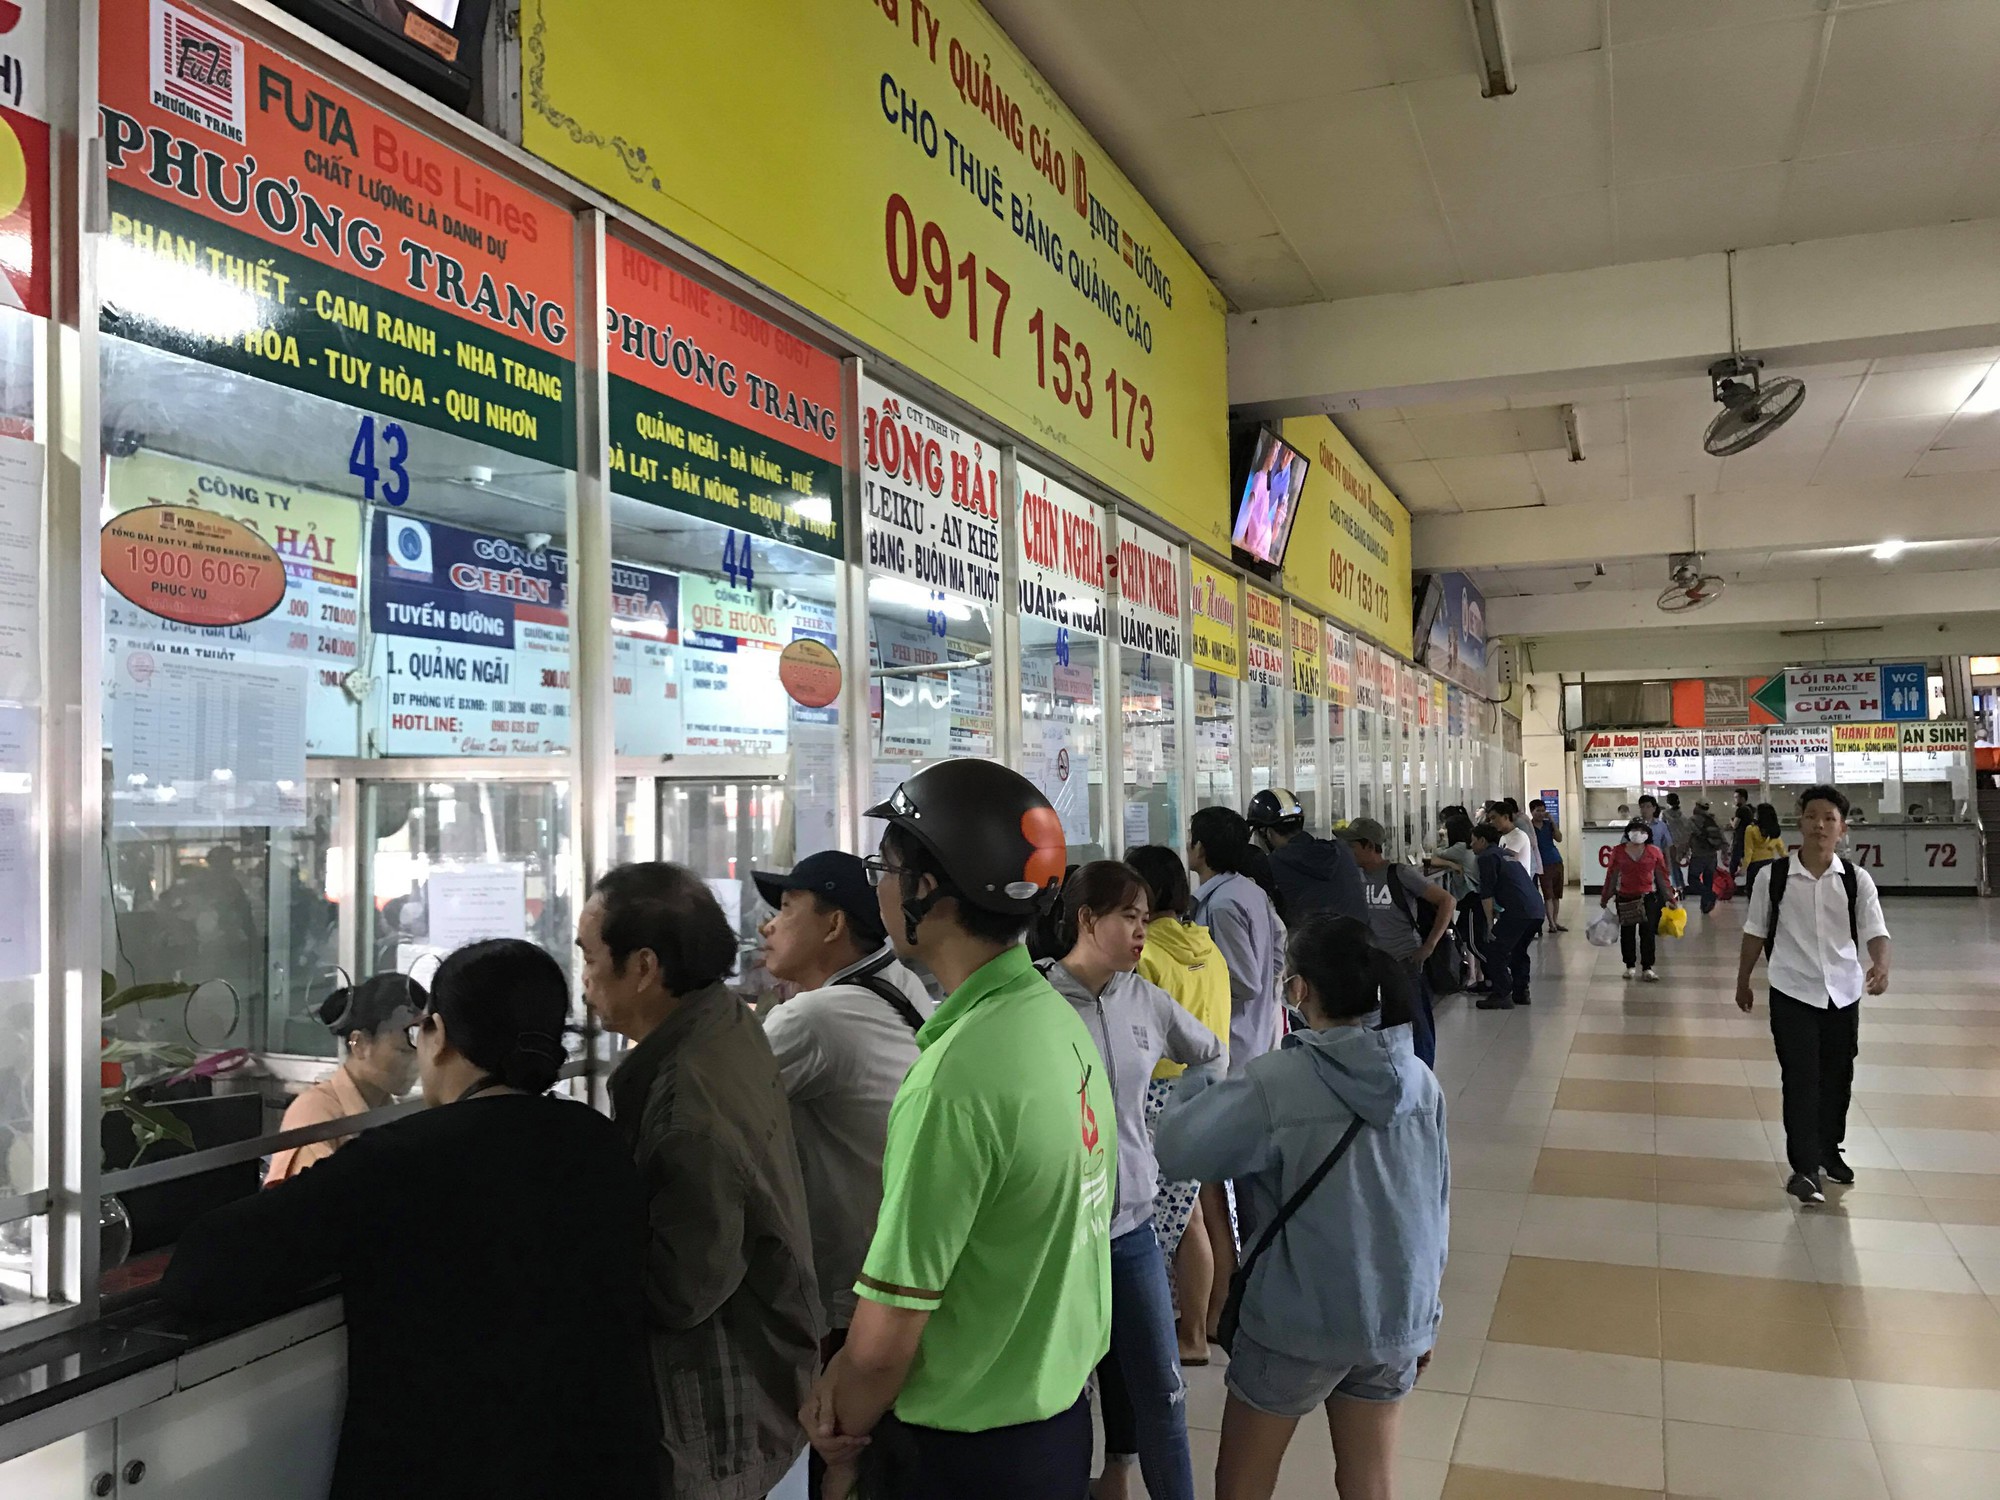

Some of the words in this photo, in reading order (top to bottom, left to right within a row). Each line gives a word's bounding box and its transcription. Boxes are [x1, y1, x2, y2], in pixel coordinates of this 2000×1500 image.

[911, 0, 940, 65] TY
[949, 37, 1024, 155] QUẢNG
[1029, 124, 1066, 195] CÁO
[204, 114, 243, 143] TRANG
[259, 64, 360, 158] FUTA
[373, 124, 444, 198] Bus
[454, 166, 538, 244] Lines
[99, 102, 386, 271] PHƯƠNG
[400, 238, 568, 345] TRANG
[304, 149, 353, 189] CHẤT
[358, 174, 415, 219] LƯỢNG
[418, 202, 438, 230] LÀ
[443, 214, 483, 250] DANH
[487, 235, 508, 264] DỰ
[880, 73, 938, 159] CHO
[944, 129, 1004, 221] THUÊ
[1011, 193, 1063, 275] BẢNG
[1068, 249, 1122, 328] QUẢNG
[1125, 304, 1152, 355] CÁO
[621, 246, 662, 293] HOT
[669, 271, 711, 318] LINE
[730, 304, 770, 348] 1900
[206, 246, 290, 305] THIẾT
[316, 289, 369, 334] CAM
[376, 311, 436, 357] RANH
[457, 341, 498, 379] NHA
[502, 357, 563, 402] TRANG
[886, 193, 1011, 359] 0917
[1029, 306, 1093, 420] 153
[1105, 367, 1154, 463] 173
[245, 323, 300, 368] HÒA
[325, 348, 372, 388] TUY
[380, 365, 426, 407] HÒA
[446, 388, 480, 423] QUI
[486, 402, 538, 441] NHƠN
[607, 305, 738, 398] PHƯƠNG
[745, 372, 838, 442] TRANG
[906, 405, 924, 425] CTY
[926, 416, 948, 439] TNHH
[949, 429, 960, 444] VT
[349, 415, 410, 508] 43
[636, 411, 685, 449] QUẢNG
[688, 431, 719, 462] NGÃI
[730, 445, 748, 473] ĐÀ
[751, 451, 783, 485] NẴNG
[791, 471, 814, 497] HUẾ
[198, 476, 259, 505] CÔNG
[266, 491, 291, 511] TY
[609, 442, 626, 473] ĐÀ
[630, 452, 658, 484] LẠT
[672, 462, 701, 496] ĐẮK
[704, 477, 739, 509] NÔNG
[749, 493, 782, 522] BUÔN
[950, 441, 999, 523] HẢI
[867, 480, 924, 535] LEIKU
[941, 513, 963, 549] AN
[967, 524, 998, 563] KHÊ
[1330, 500, 1340, 526] CHO
[274, 520, 336, 565] HẢI
[1022, 478, 1059, 575] CHÍN
[1062, 504, 1105, 592] NGHĨA
[126, 545, 192, 580] 1900
[201, 558, 261, 590] 6067
[473, 538, 548, 572] CÔNG
[722, 528, 755, 593] 44
[450, 562, 552, 605] CHÍN
[915, 541, 946, 587] BUÔN
[949, 555, 965, 593] MA
[967, 562, 1000, 608] THUỘT
[1120, 527, 1146, 609] CHÍN
[1148, 545, 1180, 621] NGHĨA
[1330, 548, 1354, 600] 0917
[1357, 569, 1372, 613] 153
[1375, 582, 1389, 623] 173
[715, 588, 741, 605] CÔNG
[741, 594, 756, 607] TY
[1018, 572, 1069, 624] UẢNG
[386, 601, 446, 629] TUYẾN
[450, 609, 505, 636] ĐƯỜNG
[692, 603, 724, 632] QUÊ
[729, 610, 777, 637] HƯƠNG
[1055, 627, 1070, 668] 46
[1156, 626, 1180, 659] NGÃI
[388, 650, 403, 675] 1.
[409, 646, 467, 682] QUẢNG
[473, 655, 509, 686] NGÃI
[1790, 671, 1818, 685] LỐI
[1823, 672, 1848, 684] RA
[1853, 671, 1877, 683] XE
[1891, 672, 1919, 684] WC
[410, 691, 441, 709] PHÒNG
[1794, 696, 1852, 713] CỬA
[1860, 698, 1879, 711] H
[1808, 684, 1858, 693] ENTRANCE
[392, 713, 464, 733] HOTLINE:
[1820, 713, 1844, 721] GATE
[1845, 713, 1852, 721] H
[1583, 733, 1611, 753] Anh
[1643, 734, 1673, 748] THÀNH
[1675, 735, 1700, 748] CÔNG
[1704, 732, 1735, 747] THÀNH
[1737, 731, 1762, 746] CÔNG
[1770, 746, 1799, 754] NINH
[1803, 745, 1828, 753] SƠN
[1800, 738, 1828, 746] RANG
[1835, 742, 1847, 752] TUY
[1903, 729, 1924, 744] AN
[1929, 727, 1967, 742] SINH
[1606, 759, 1615, 768] 67
[1614, 751, 1639, 759] THUỘT
[1667, 758, 1677, 767] 68
[1795, 754, 1804, 763] 70
[1861, 752, 1870, 761] 71
[1927, 751, 1937, 760] 72
[1855, 843, 1885, 868] 71
[1924, 843, 1957, 868] 72
[1366, 884, 1393, 905] ILA
